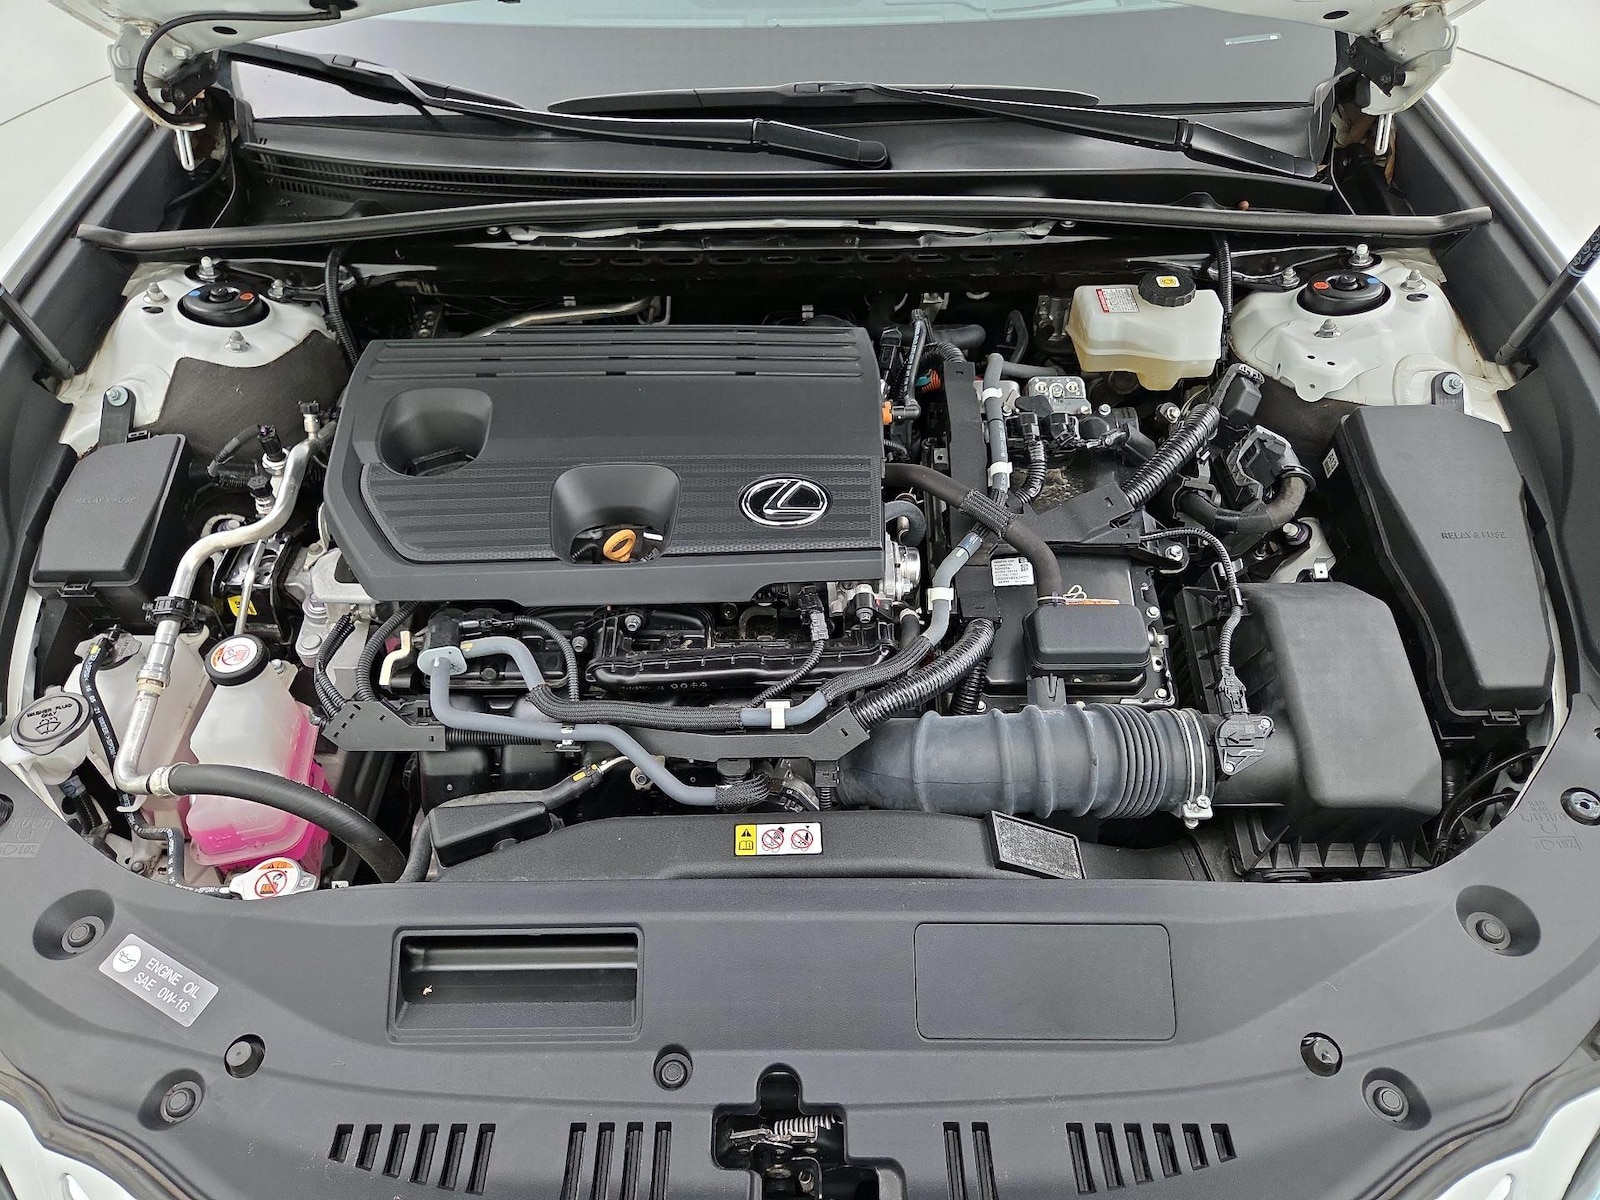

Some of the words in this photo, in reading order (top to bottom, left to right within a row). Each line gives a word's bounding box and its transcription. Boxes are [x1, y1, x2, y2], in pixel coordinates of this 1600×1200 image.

[1440, 531, 1471, 540] RELAY
[1481, 530, 1507, 539] FUSE
[133, 971, 157, 992] SAE
[157, 987, 191, 1013] 0W-16
[145, 957, 183, 986] ENGINE
[182, 981, 201, 999] OIL
